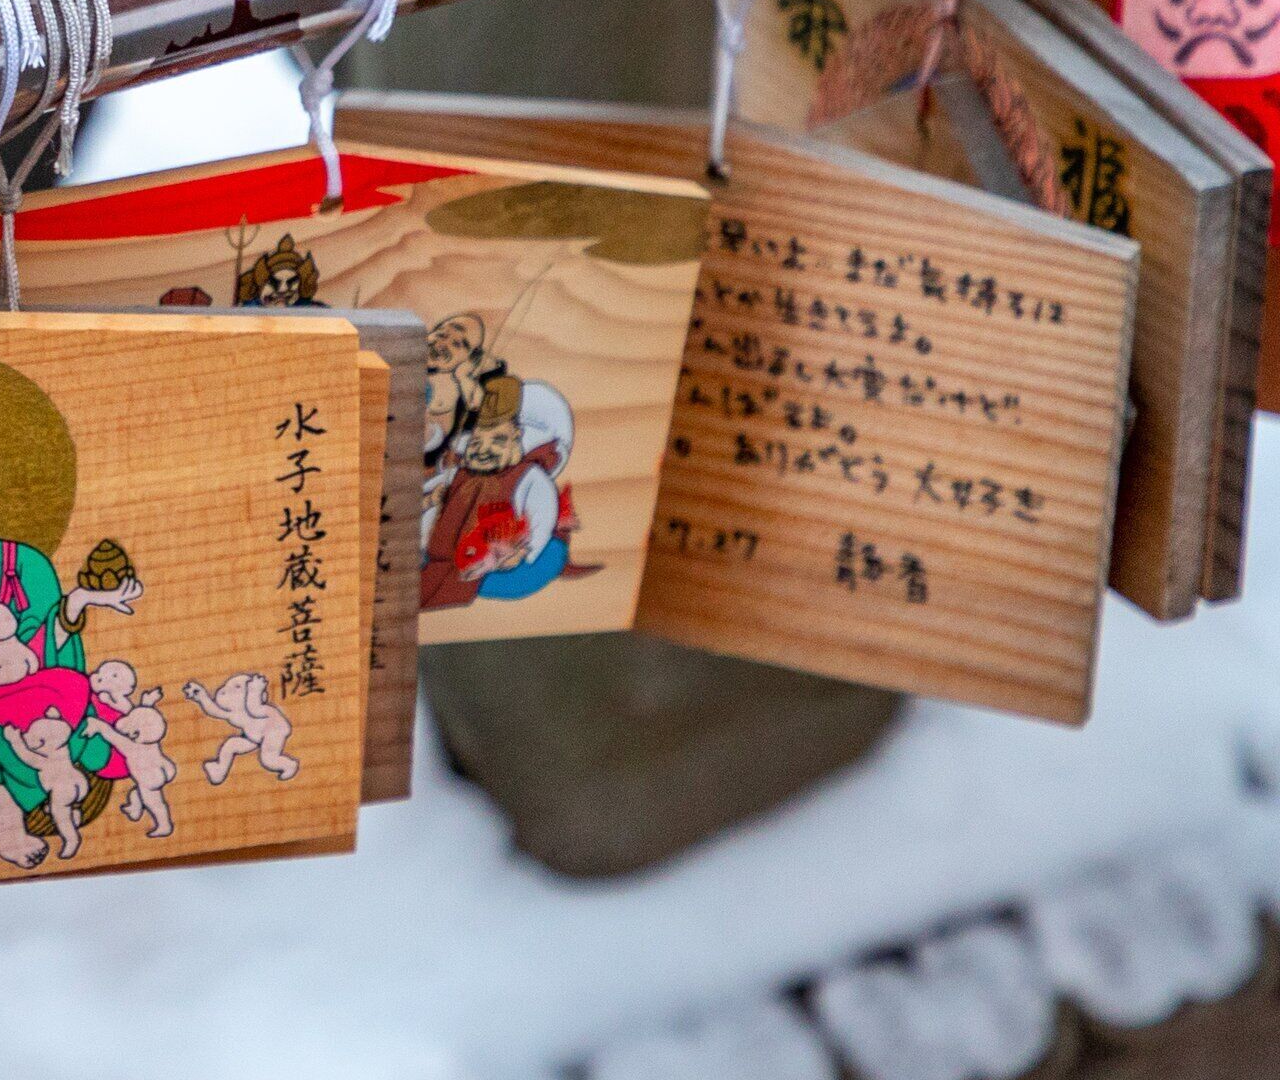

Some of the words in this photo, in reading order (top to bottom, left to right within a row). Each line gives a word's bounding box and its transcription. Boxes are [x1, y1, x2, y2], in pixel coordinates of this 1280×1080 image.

[274, 402, 327, 699] 水子地蔵菩薩
